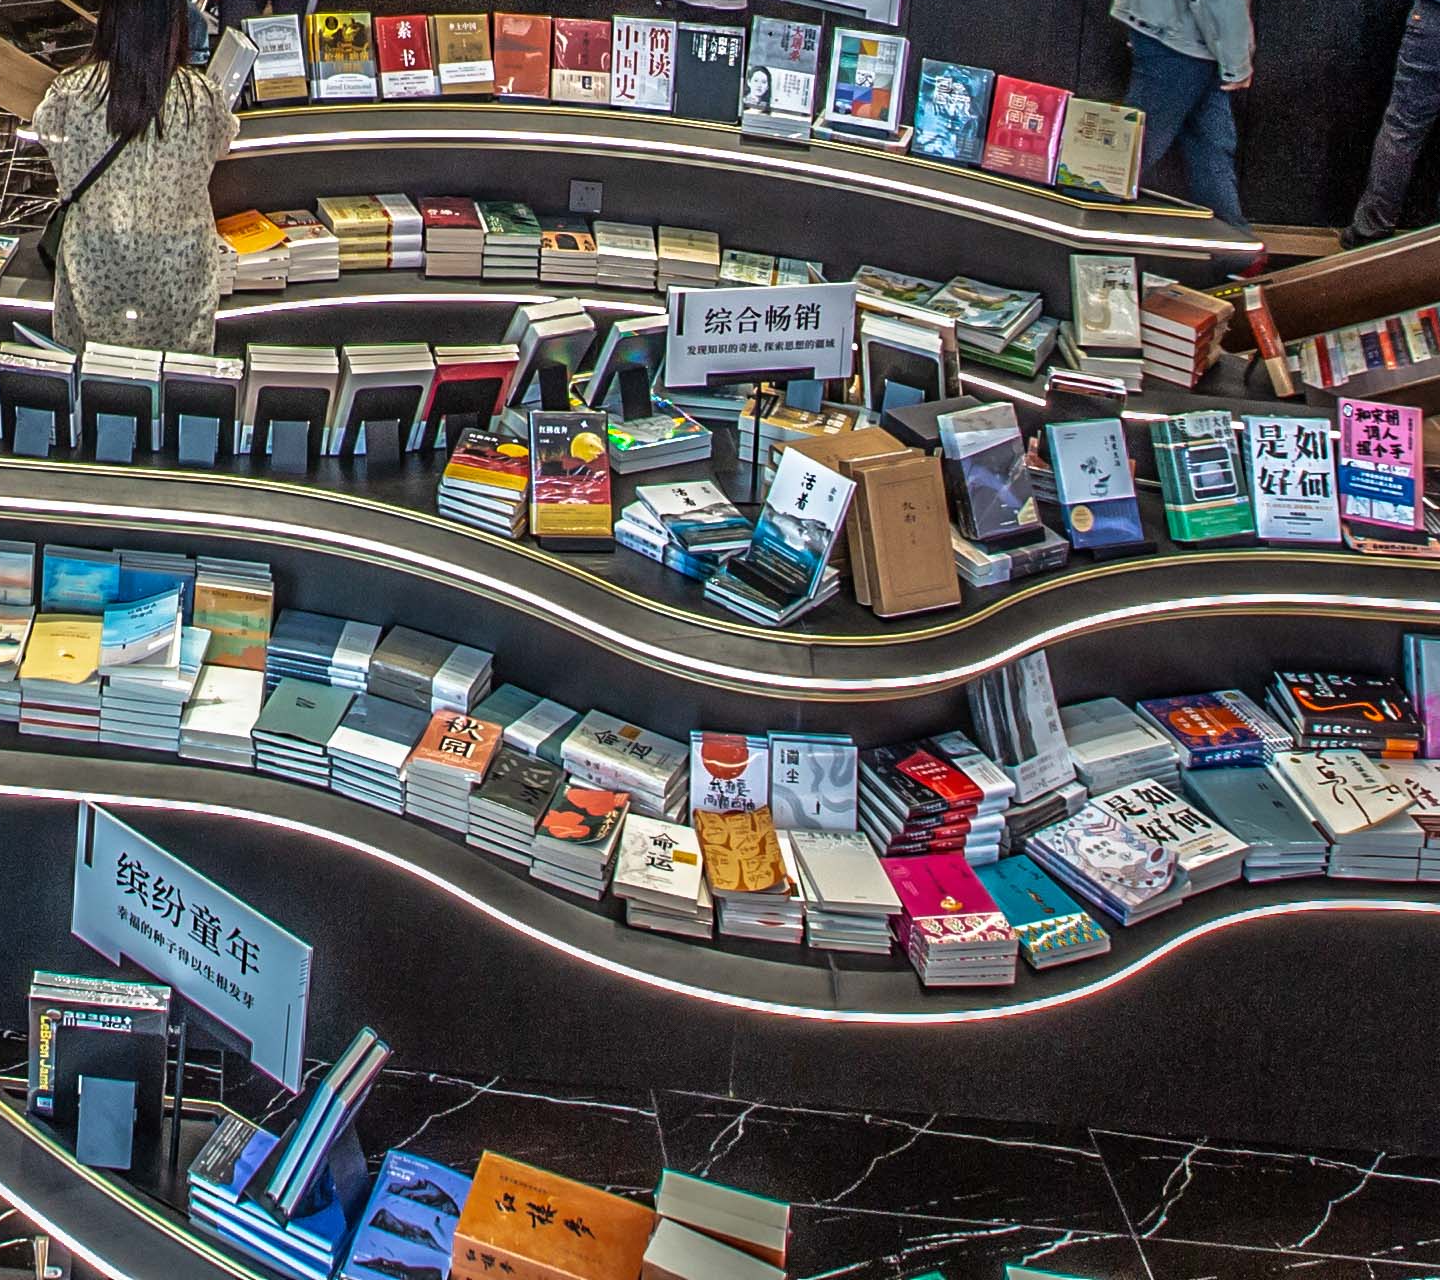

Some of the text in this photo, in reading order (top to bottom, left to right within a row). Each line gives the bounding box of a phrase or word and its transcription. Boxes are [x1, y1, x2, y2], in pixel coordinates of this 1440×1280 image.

[395, 19, 417, 67] 素书
[615, 24, 640, 101] 中国史
[647, 26, 673, 79] 简读
[704, 302, 823, 335] 综合畅销
[1354, 408, 1400, 427] 和宋朝
[1363, 425, 1398, 441] 词人
[1256, 423, 1292, 499] 是好
[1293, 425, 1332, 499] 如何
[1355, 440, 1404, 459] 握个手
[793, 472, 817, 511] 活着
[441, 716, 485, 758] 秋园
[646, 831, 681, 873] 命运
[115, 851, 263, 976] 缤纷童年
[117, 904, 257, 1011] 幸福的种子得以生根发芽
[38, 1013, 51, 1064] LeBron
